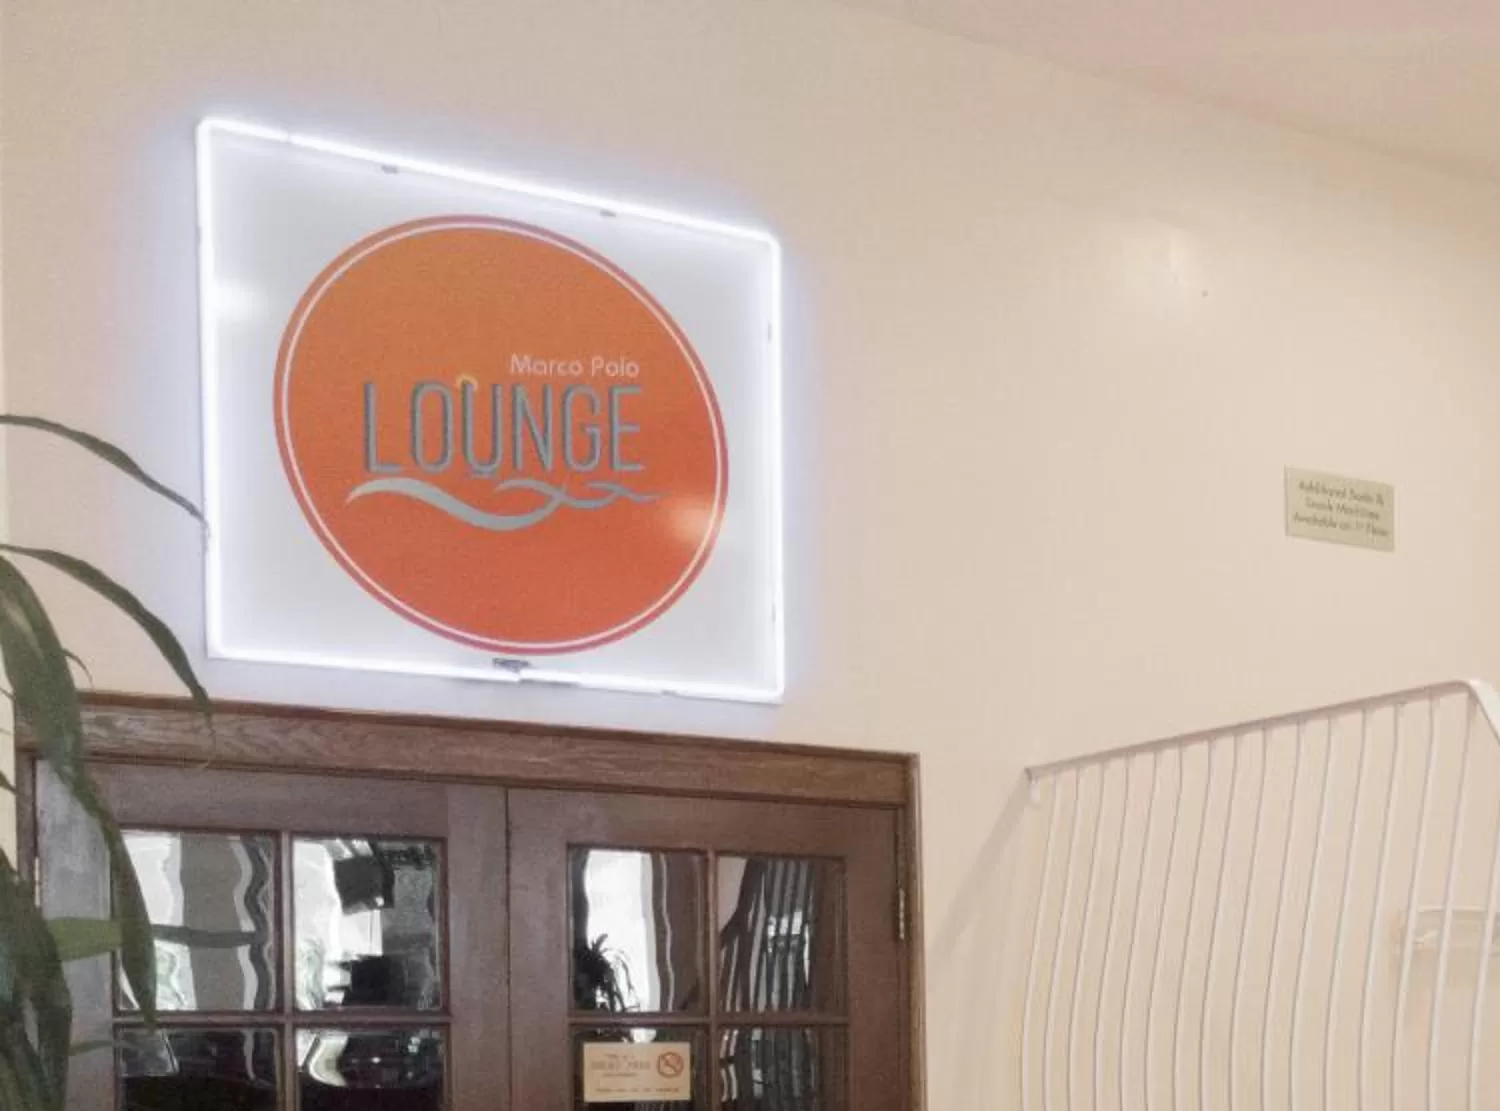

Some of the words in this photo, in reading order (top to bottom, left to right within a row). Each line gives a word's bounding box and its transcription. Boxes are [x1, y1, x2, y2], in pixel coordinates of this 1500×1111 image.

[510, 352, 583, 376] Marco
[590, 356, 641, 378] Polo
[362, 380, 647, 476] LOUNGE
